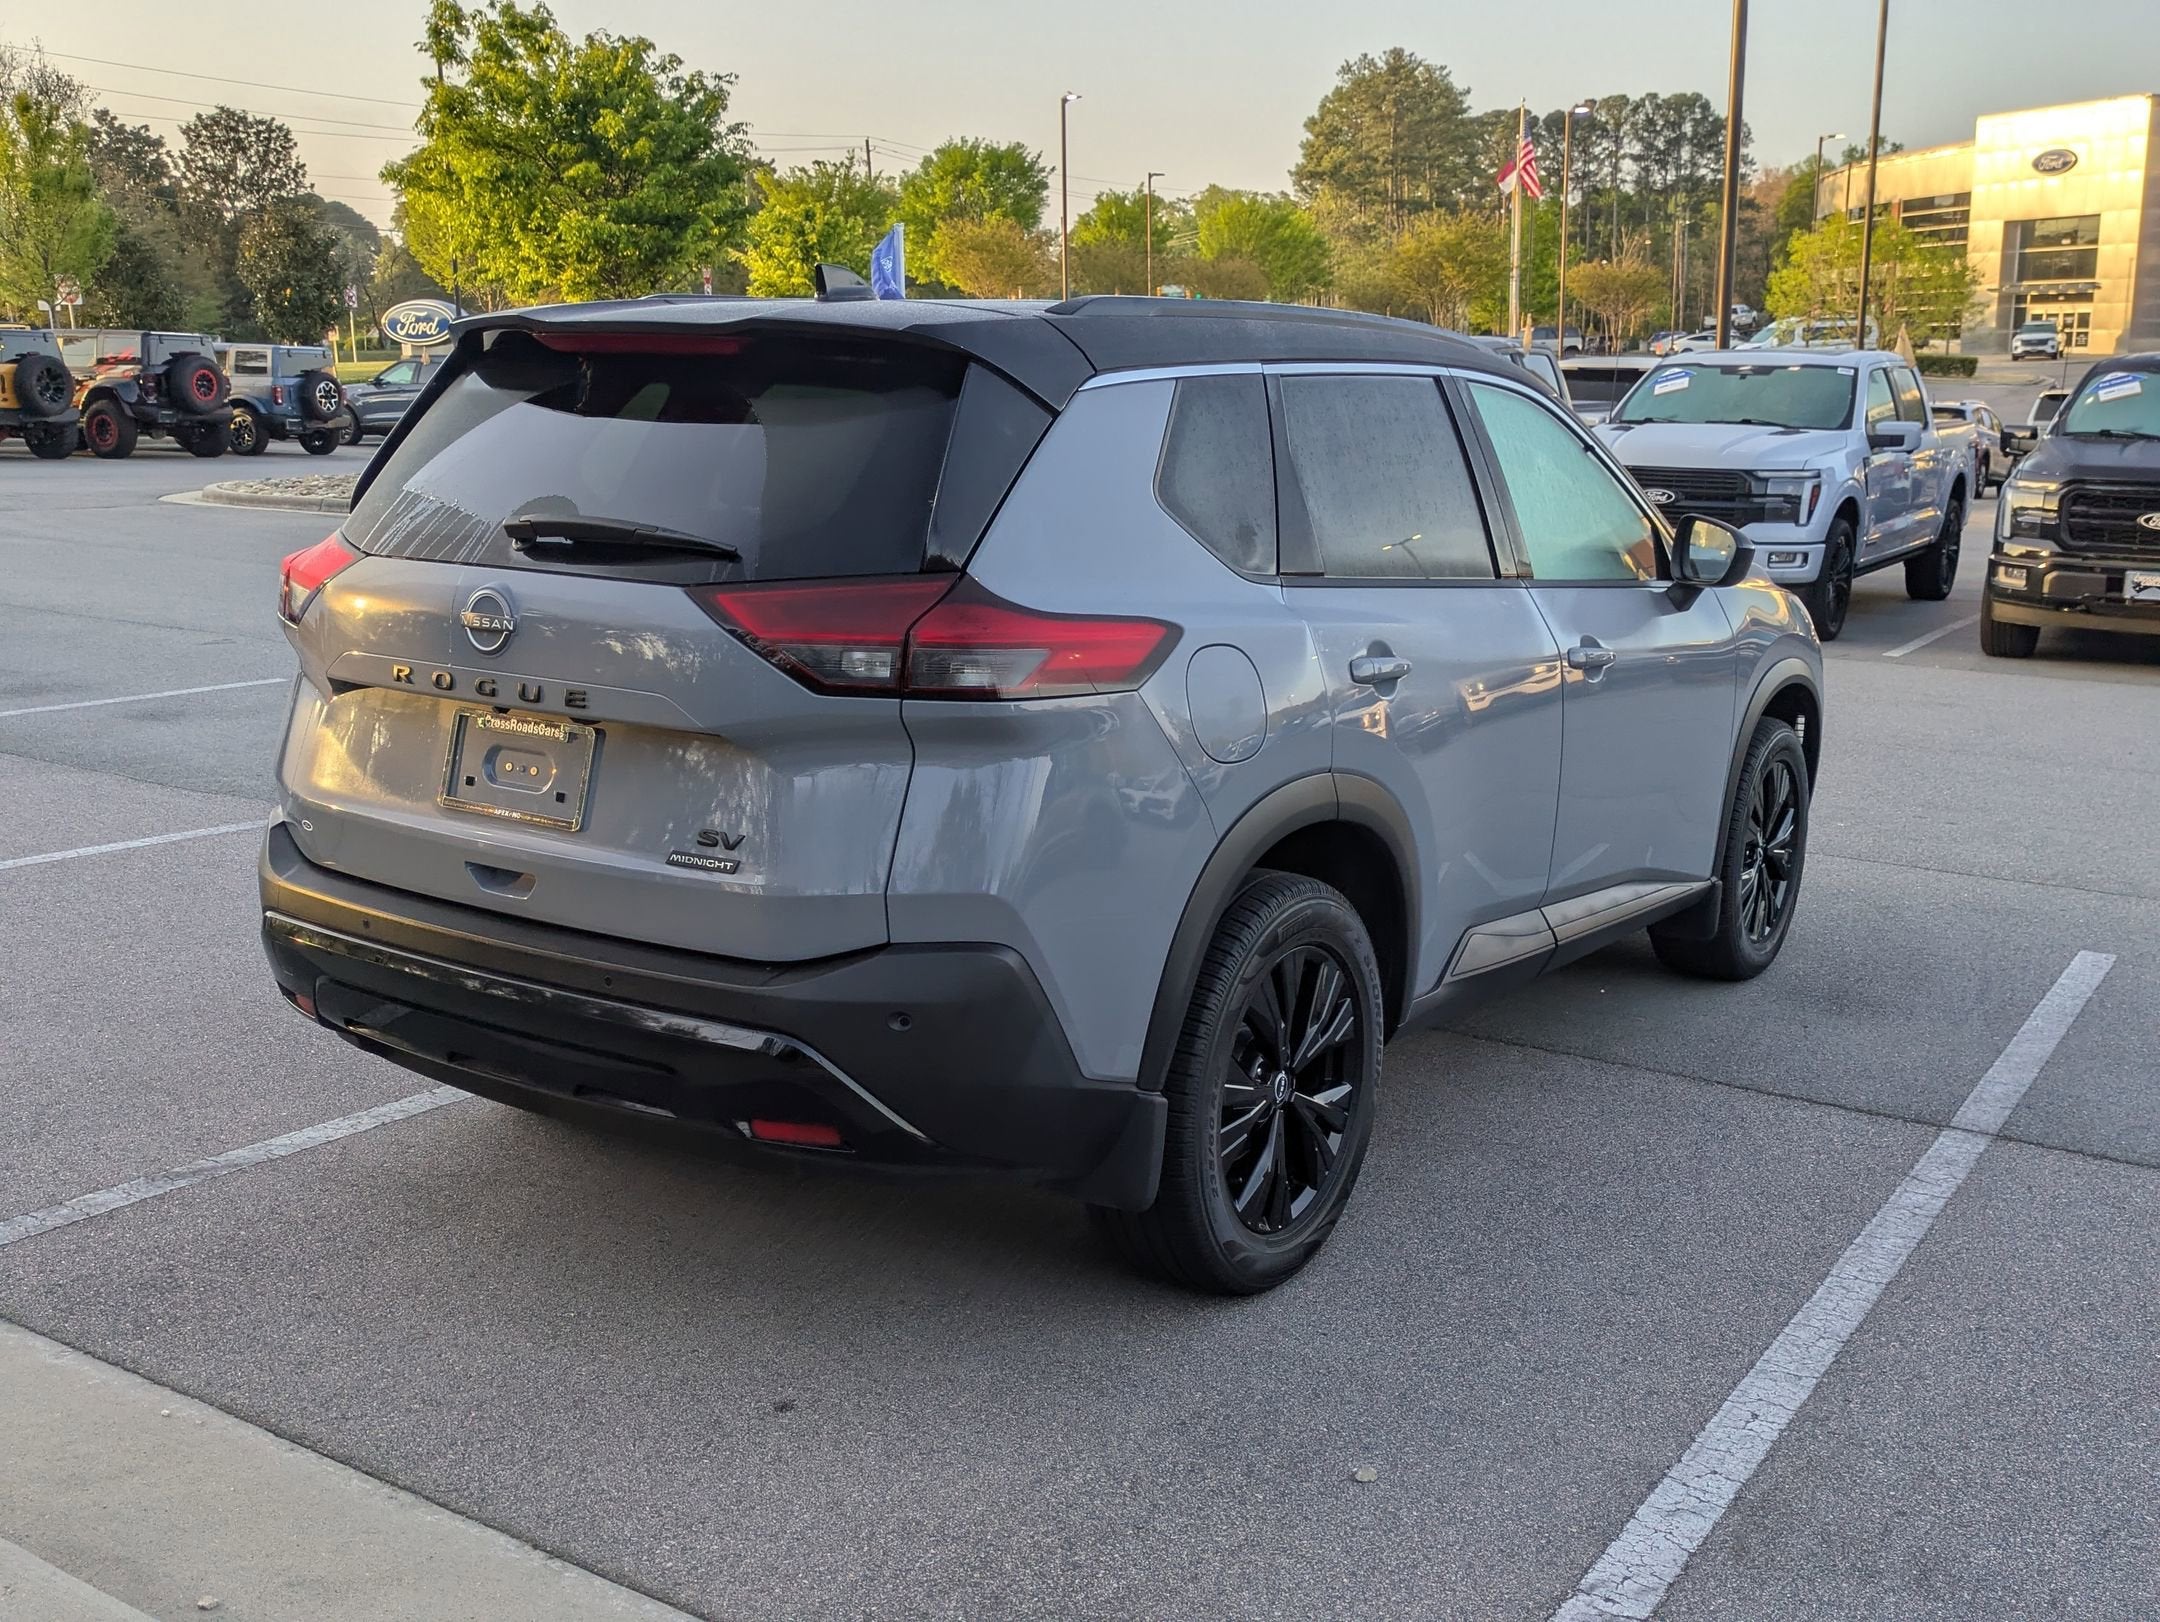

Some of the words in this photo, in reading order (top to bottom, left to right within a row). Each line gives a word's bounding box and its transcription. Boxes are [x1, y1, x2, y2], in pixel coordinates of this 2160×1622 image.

[396, 311, 440, 336] Ford
[460, 614, 514, 631] NISSAN
[392, 663, 588, 709] ROGUE
[697, 829, 746, 851] SV
[670, 853, 734, 870] MIDNIGHT
[1363, 954, 1383, 1088] SCORPION
